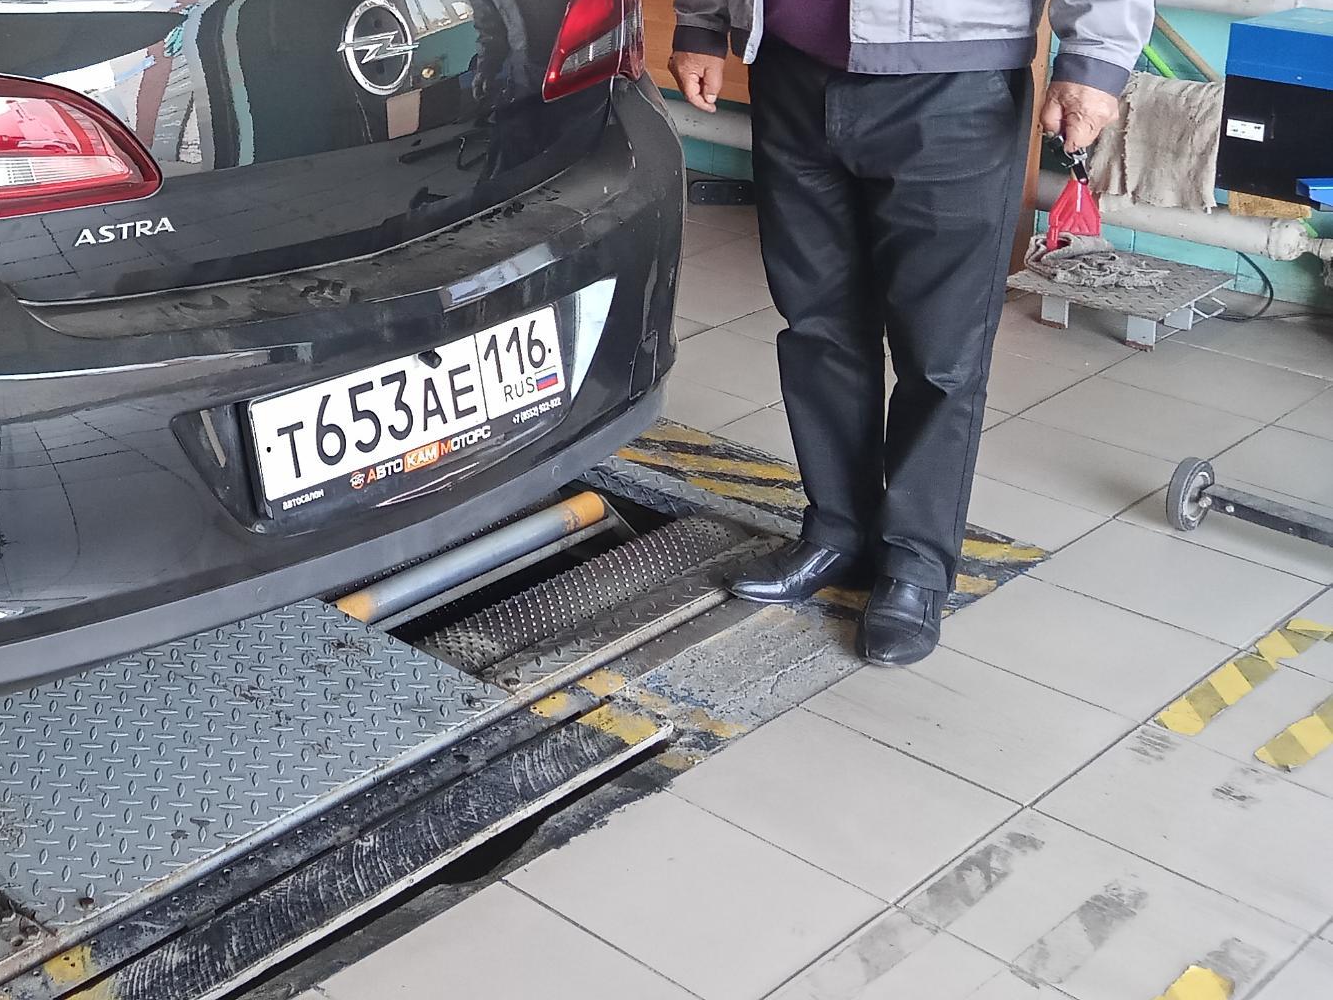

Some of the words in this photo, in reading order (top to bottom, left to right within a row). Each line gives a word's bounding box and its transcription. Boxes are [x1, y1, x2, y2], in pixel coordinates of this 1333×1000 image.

[74, 217, 177, 247] ASTRA
[483, 320, 547, 384] 116
[503, 375, 536, 402] RUS
